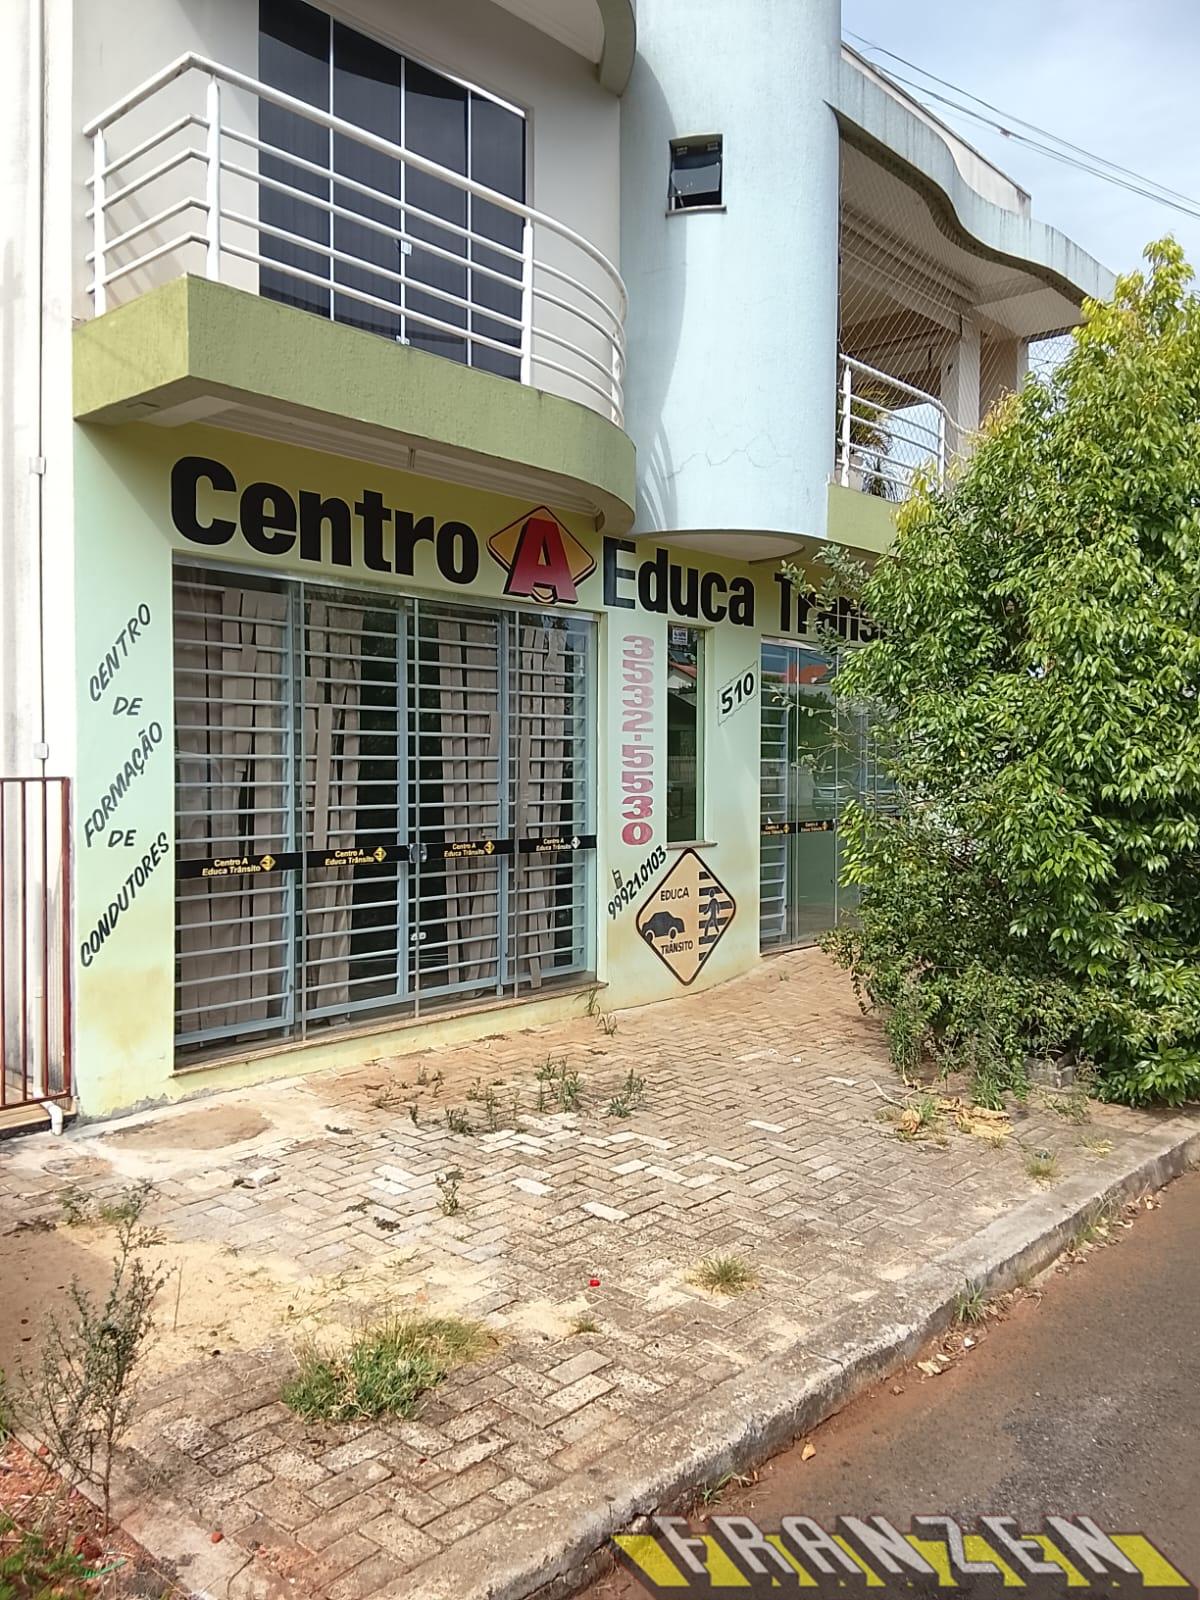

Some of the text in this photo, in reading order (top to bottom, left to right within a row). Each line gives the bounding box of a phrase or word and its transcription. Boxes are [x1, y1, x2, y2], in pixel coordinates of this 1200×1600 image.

[170, 456, 480, 585] Centro
[502, 516, 579, 604] A
[603, 536, 755, 627] Educa
[88, 603, 151, 702] CENTRO
[720, 672, 755, 715] 510
[112, 696, 143, 716] DE
[83, 721, 163, 848] FORMAÇÃO
[107, 829, 137, 847] DE
[214, 857, 249, 868] Centro A
[325, 857, 347, 866] Educa
[335, 848, 364, 859] Centro A
[202, 867, 228, 877] Educa
[608, 845, 667, 920] 99921.0103
[79, 832, 170, 967] CONDUTORES
[660, 887, 690, 901] EDUCA
